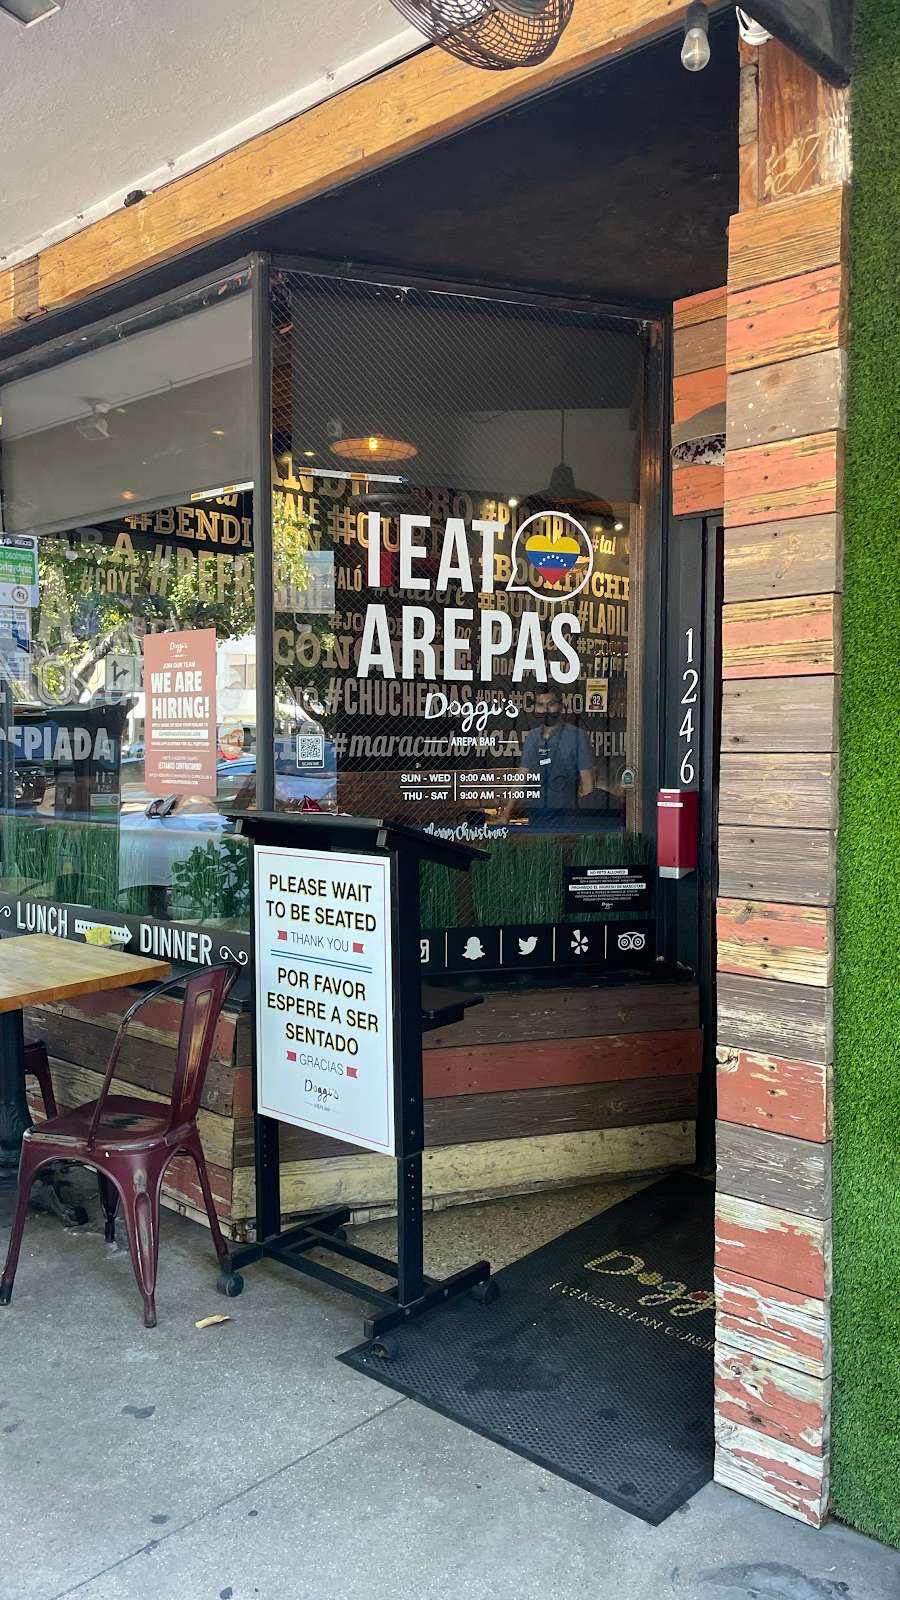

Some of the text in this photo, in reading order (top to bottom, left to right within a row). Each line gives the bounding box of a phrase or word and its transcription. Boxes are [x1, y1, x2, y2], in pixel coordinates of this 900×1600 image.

[368, 511, 380, 587] I
[400, 513, 505, 593] EAT
[357, 604, 581, 684] AREPAS
[151, 671, 203, 693] WE ARE
[151, 696, 210, 719] HIRING!
[425, 693, 519, 732] Doggi's
[679, 628, 699, 783] 1246
[451, 736, 496, 746] AREPA BAR
[401, 774, 421, 782] SUN
[429, 774, 451, 782] WED
[460, 774, 478, 782] 9:00
[527, 773, 540, 781] PM
[403, 792, 423, 800] THU
[431, 792, 448, 800] SAT
[460, 791, 478, 799] 9:00
[480, 791, 495, 799] AM
[503, 791, 525, 799] 11:00
[527, 791, 540, 799] PM
[269, 874, 372, 903] PLEASE WAIT
[266, 900, 377, 932] TO BE SEATED
[17, 901, 213, 965] LUNCH DINNER
[290, 932, 349, 952] THANK YOU
[278, 967, 366, 1001] POR FAVOR
[267, 992, 378, 1033] ESPERE A SER
[285, 1023, 359, 1056] SENTADO
[299, 1054, 344, 1075] GRACIAS
